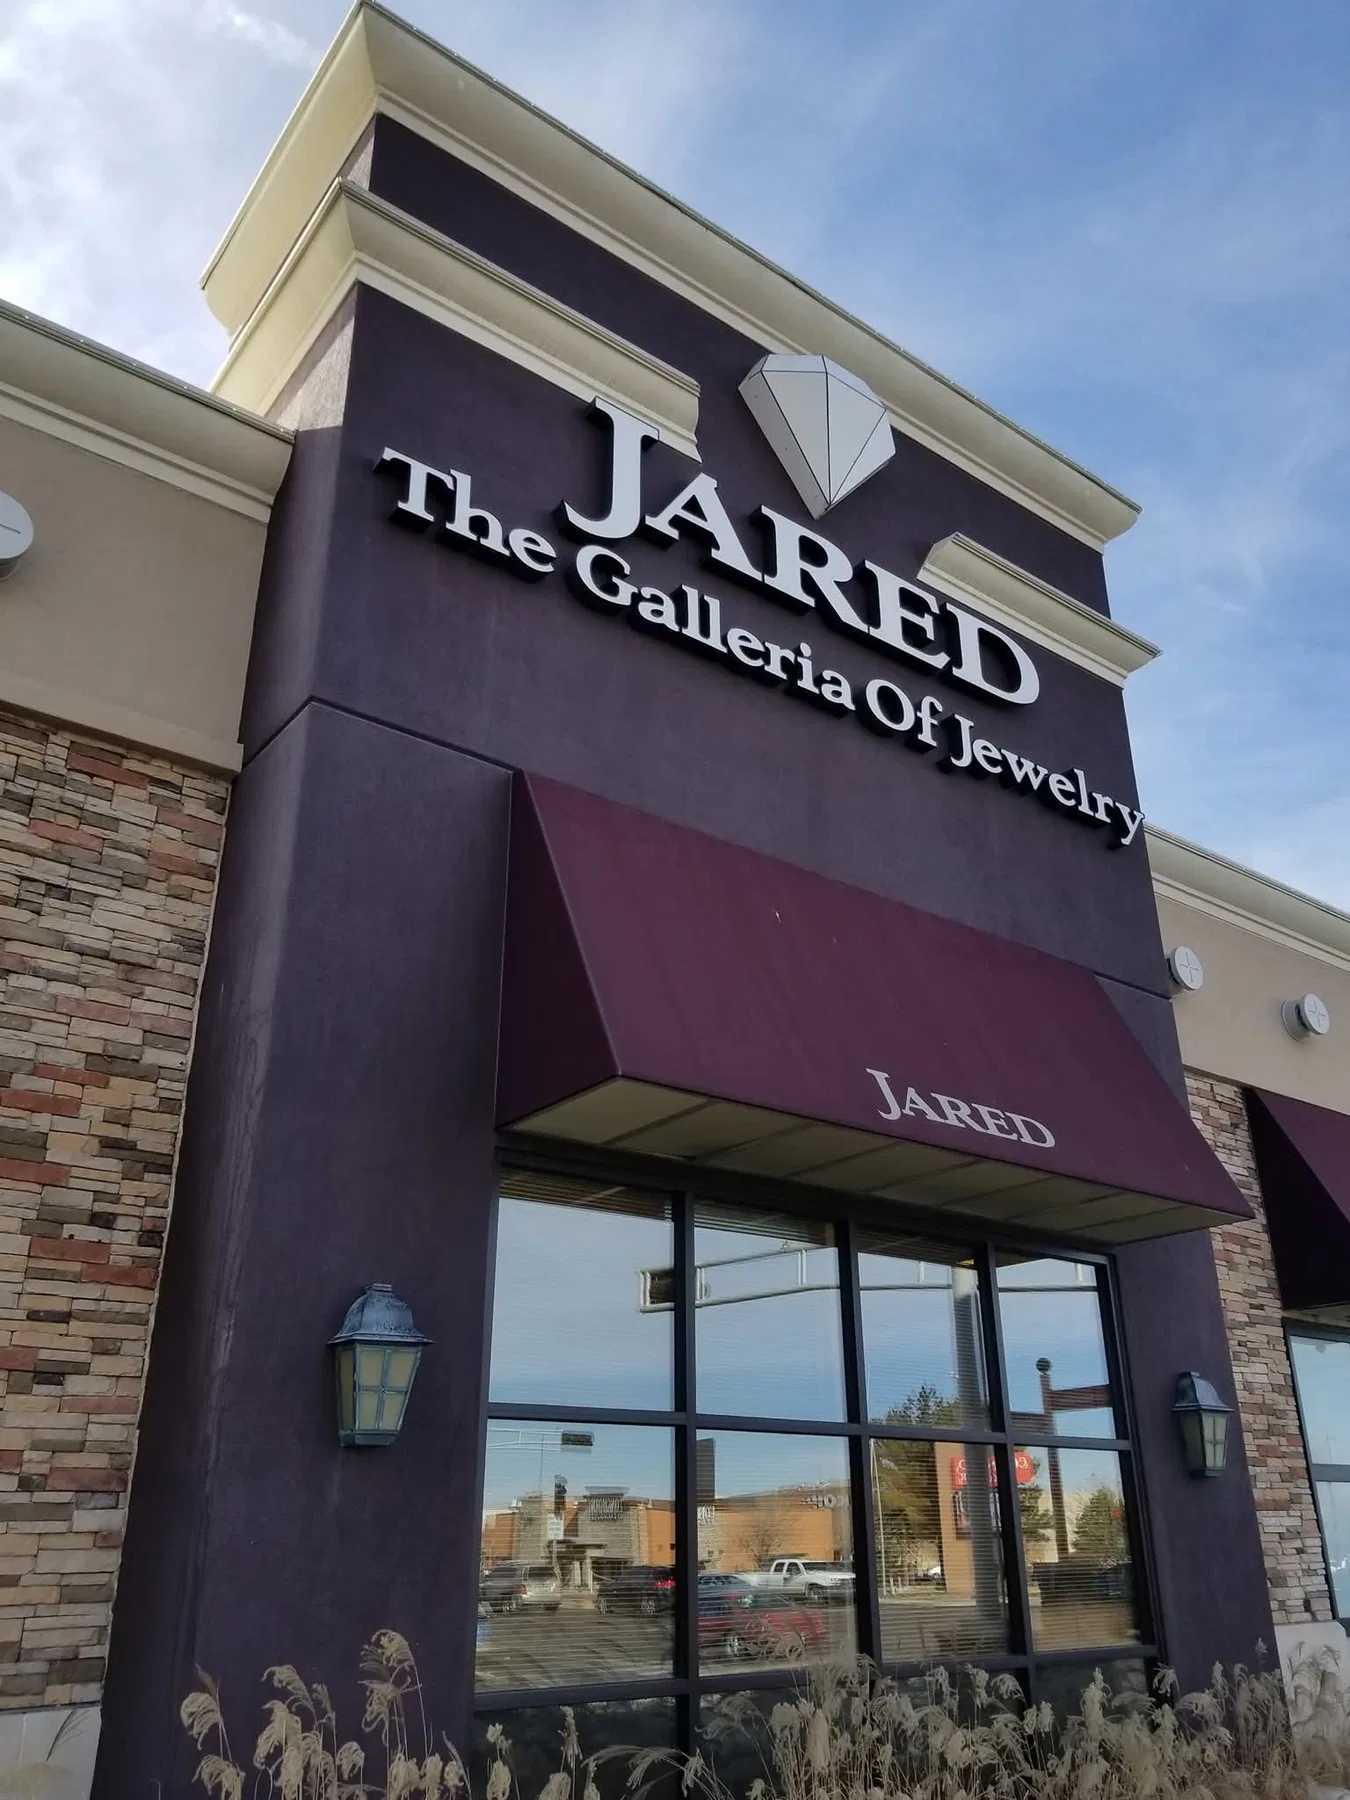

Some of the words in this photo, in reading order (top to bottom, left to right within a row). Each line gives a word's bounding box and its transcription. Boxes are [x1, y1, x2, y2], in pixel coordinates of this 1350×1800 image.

[381, 447, 556, 573] The
[574, 545, 856, 710] Galleria
[865, 678, 943, 747] Of
[950, 713, 1145, 847] Jewelry
[563, 397, 1039, 704] JARED
[865, 1068, 1056, 1148] JARED
